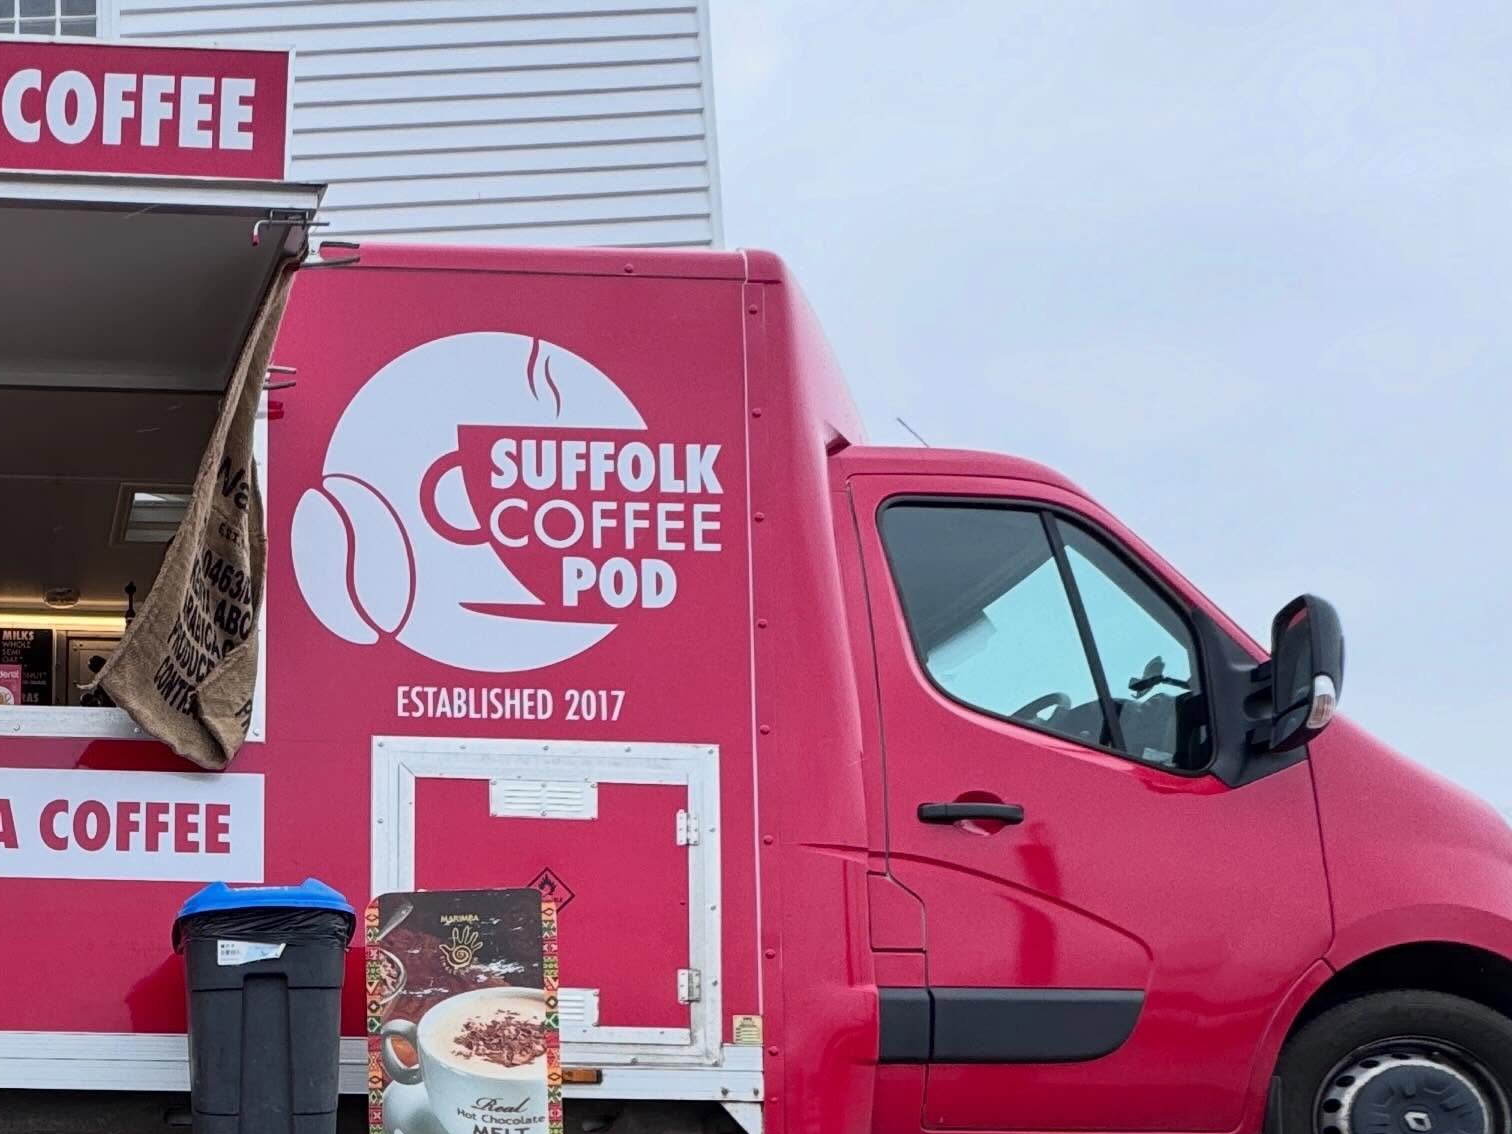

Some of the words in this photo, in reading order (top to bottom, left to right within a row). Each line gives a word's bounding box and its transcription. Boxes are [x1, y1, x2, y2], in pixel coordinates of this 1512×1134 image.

[1, 69, 256, 150] COFFEE
[491, 438, 724, 494] SUFFOLK
[490, 498, 723, 551] COFFEE
[562, 556, 678, 609] POD
[2, 630, 35, 641] MILKS
[397, 686, 553, 720] ESTABLISHED
[564, 690, 626, 721] 2017
[39, 799, 231, 854] COFFEE
[457, 1107, 477, 1120] Hot
[481, 1114, 546, 1126] Chocolate
[471, 1097, 531, 1113] Real
